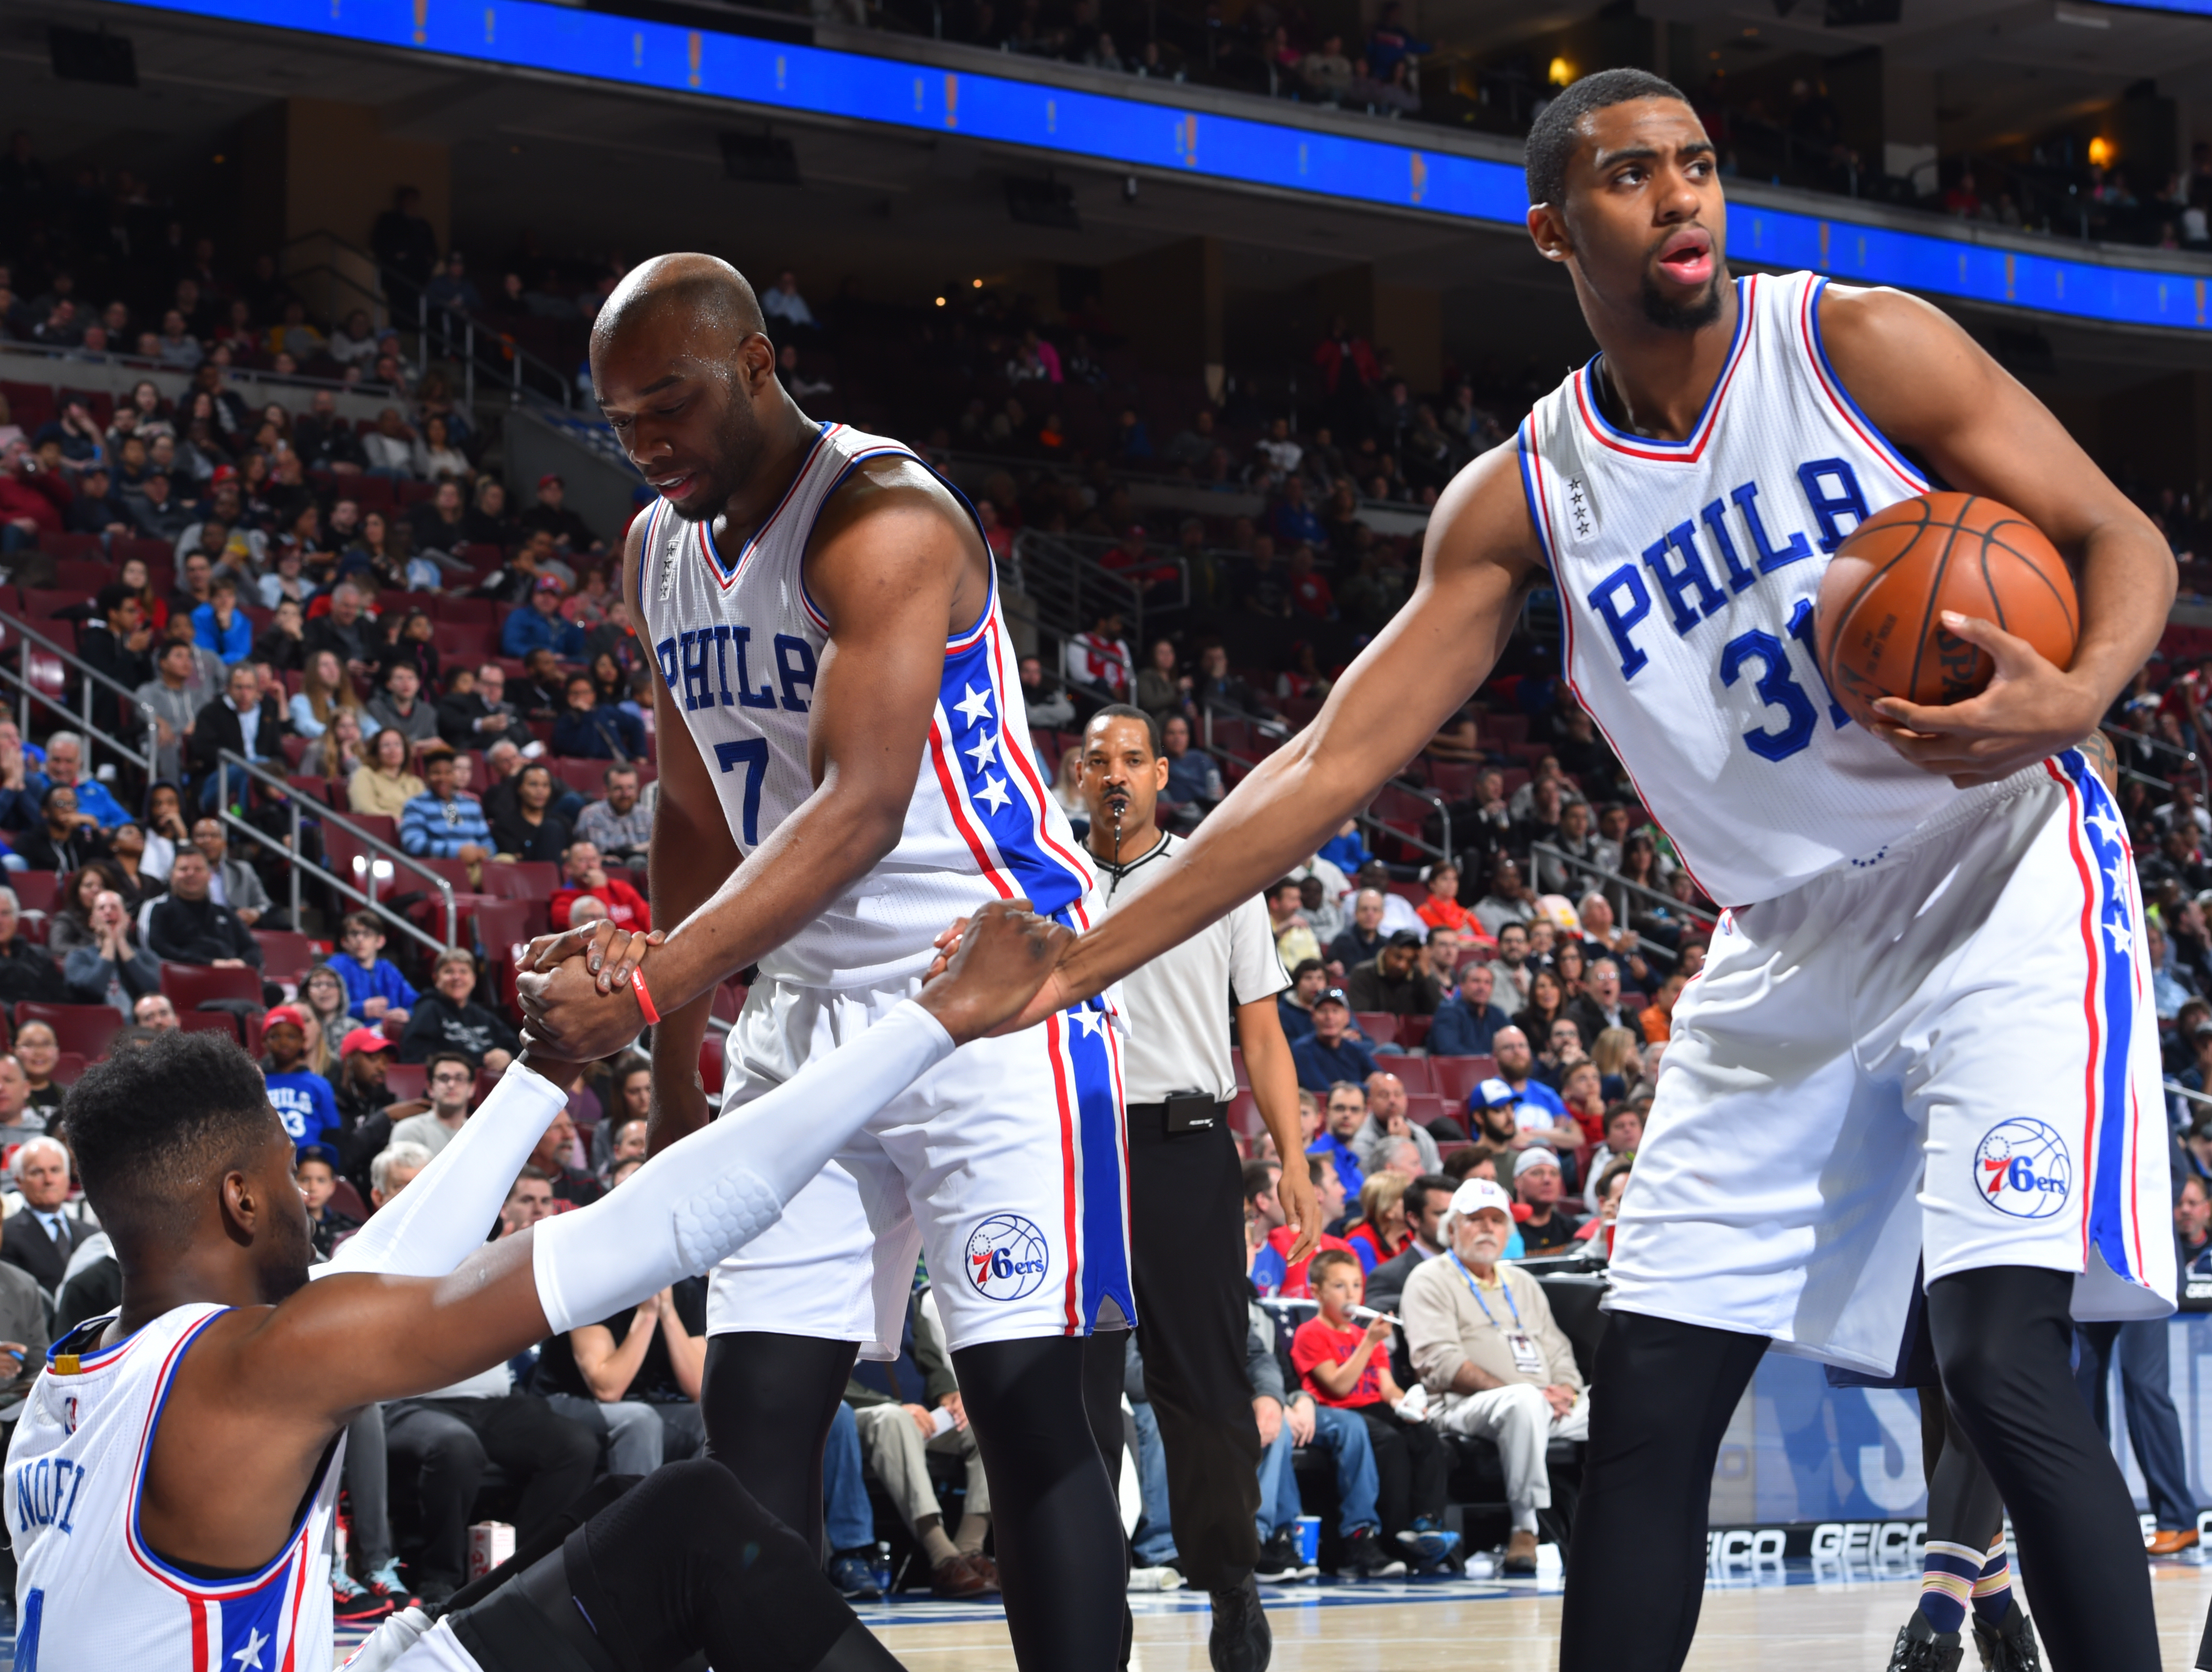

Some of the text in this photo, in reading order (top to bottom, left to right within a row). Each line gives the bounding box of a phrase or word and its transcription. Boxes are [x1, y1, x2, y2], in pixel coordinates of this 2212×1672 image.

[1588, 457, 1871, 681] PHILA
[657, 626, 817, 712] PHILA
[713, 737, 769, 846] 7
[1984, 1156, 2066, 1195] 76ers
[972, 1247, 1044, 1285] 76ers
